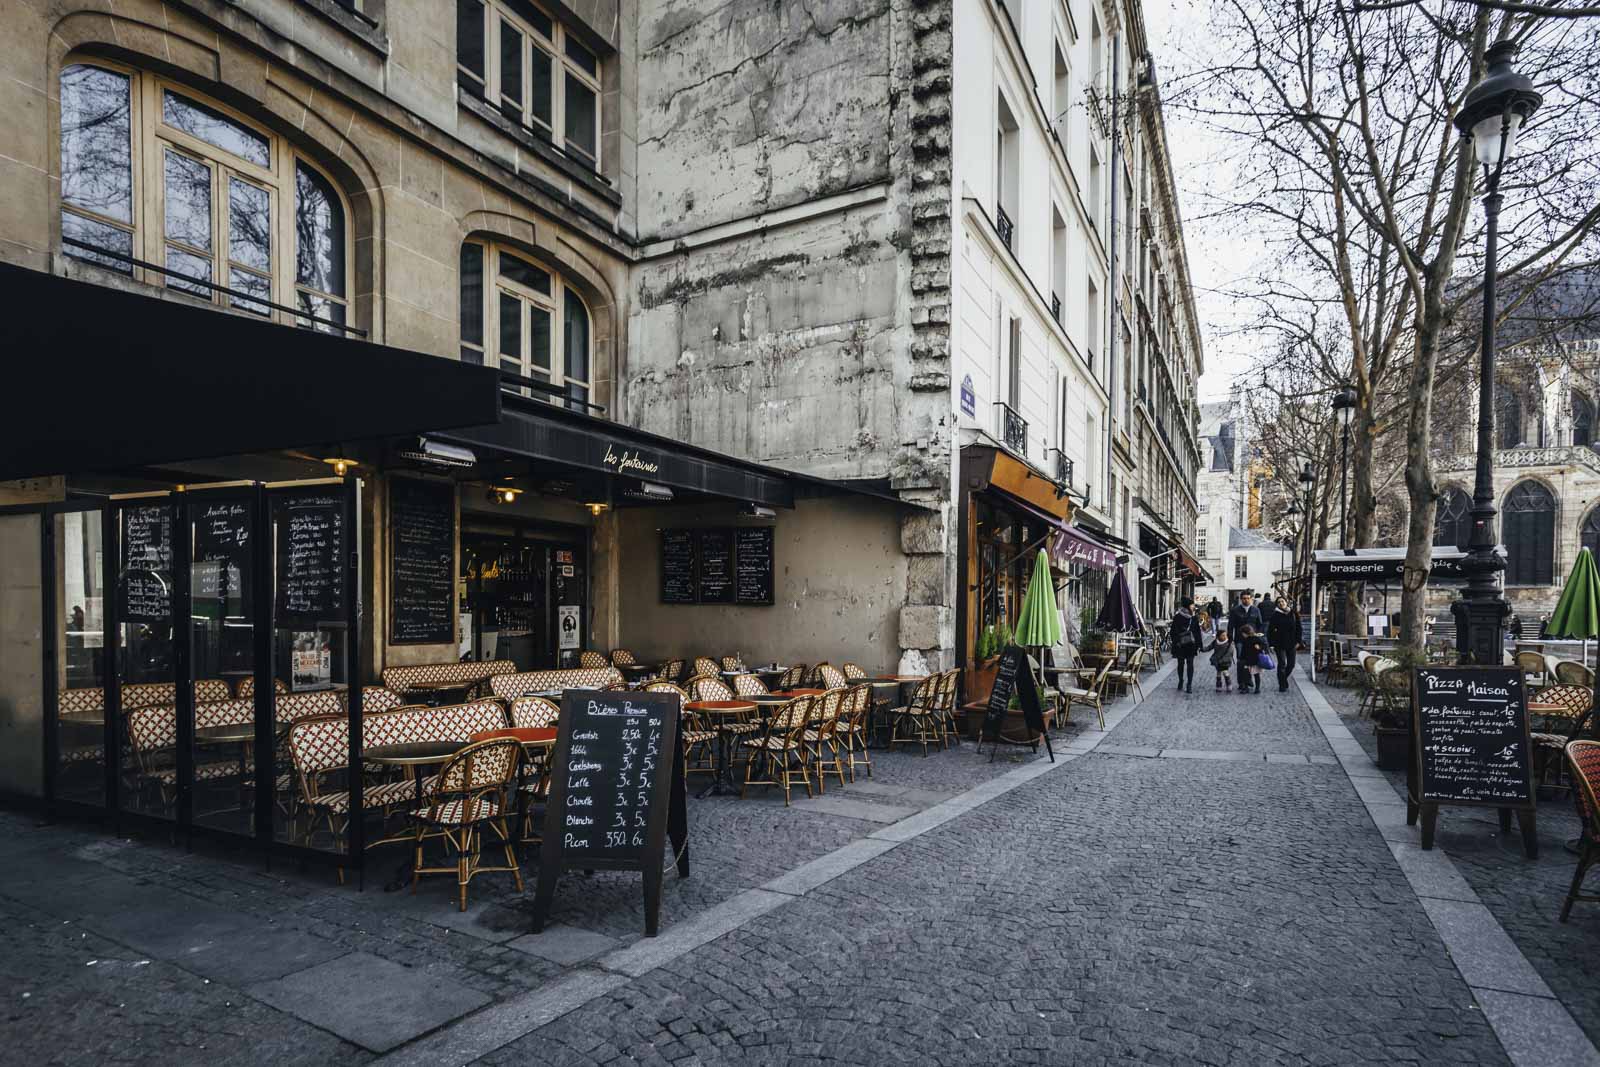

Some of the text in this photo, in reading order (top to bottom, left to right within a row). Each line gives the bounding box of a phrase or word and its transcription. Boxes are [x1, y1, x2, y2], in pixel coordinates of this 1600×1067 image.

[1330, 563, 1384, 572] brasserie
[588, 700, 618, 715] Bières
[570, 742, 658, 756] 1664 3€ 5€
[568, 756, 655, 772] Carlsberg 3€ 5€
[568, 772, 652, 789] Leffe 3€ 5€
[616, 792, 629, 807] 3€
[637, 791, 649, 807] 5€
[566, 811, 646, 827] Blanche 3€ 5€
[564, 833, 590, 849] Picon
[632, 831, 644, 846] 6€
